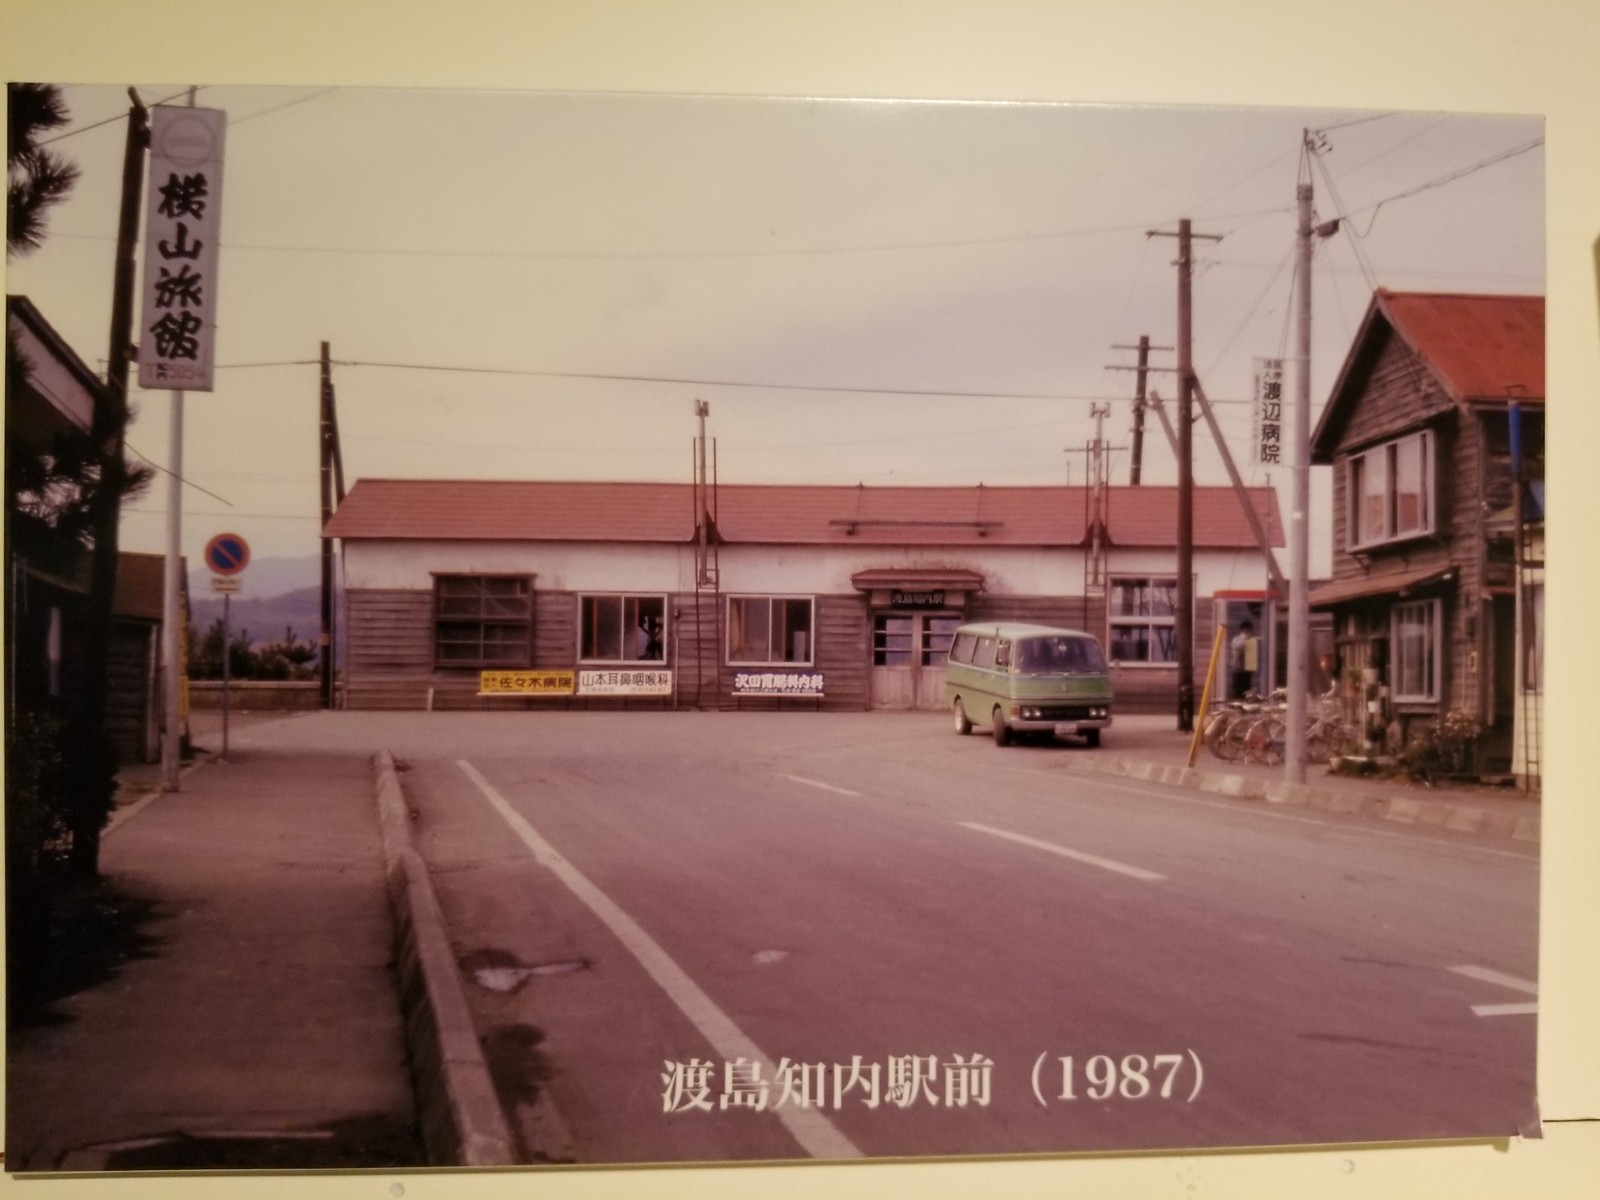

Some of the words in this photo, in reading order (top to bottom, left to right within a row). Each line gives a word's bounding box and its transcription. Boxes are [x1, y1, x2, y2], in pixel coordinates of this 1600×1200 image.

[1260, 381, 1282, 464] 渡辺病院
[500, 676, 572, 688] 佐々木病院
[582, 672, 669, 687] 山本耳鼻咽喉科
